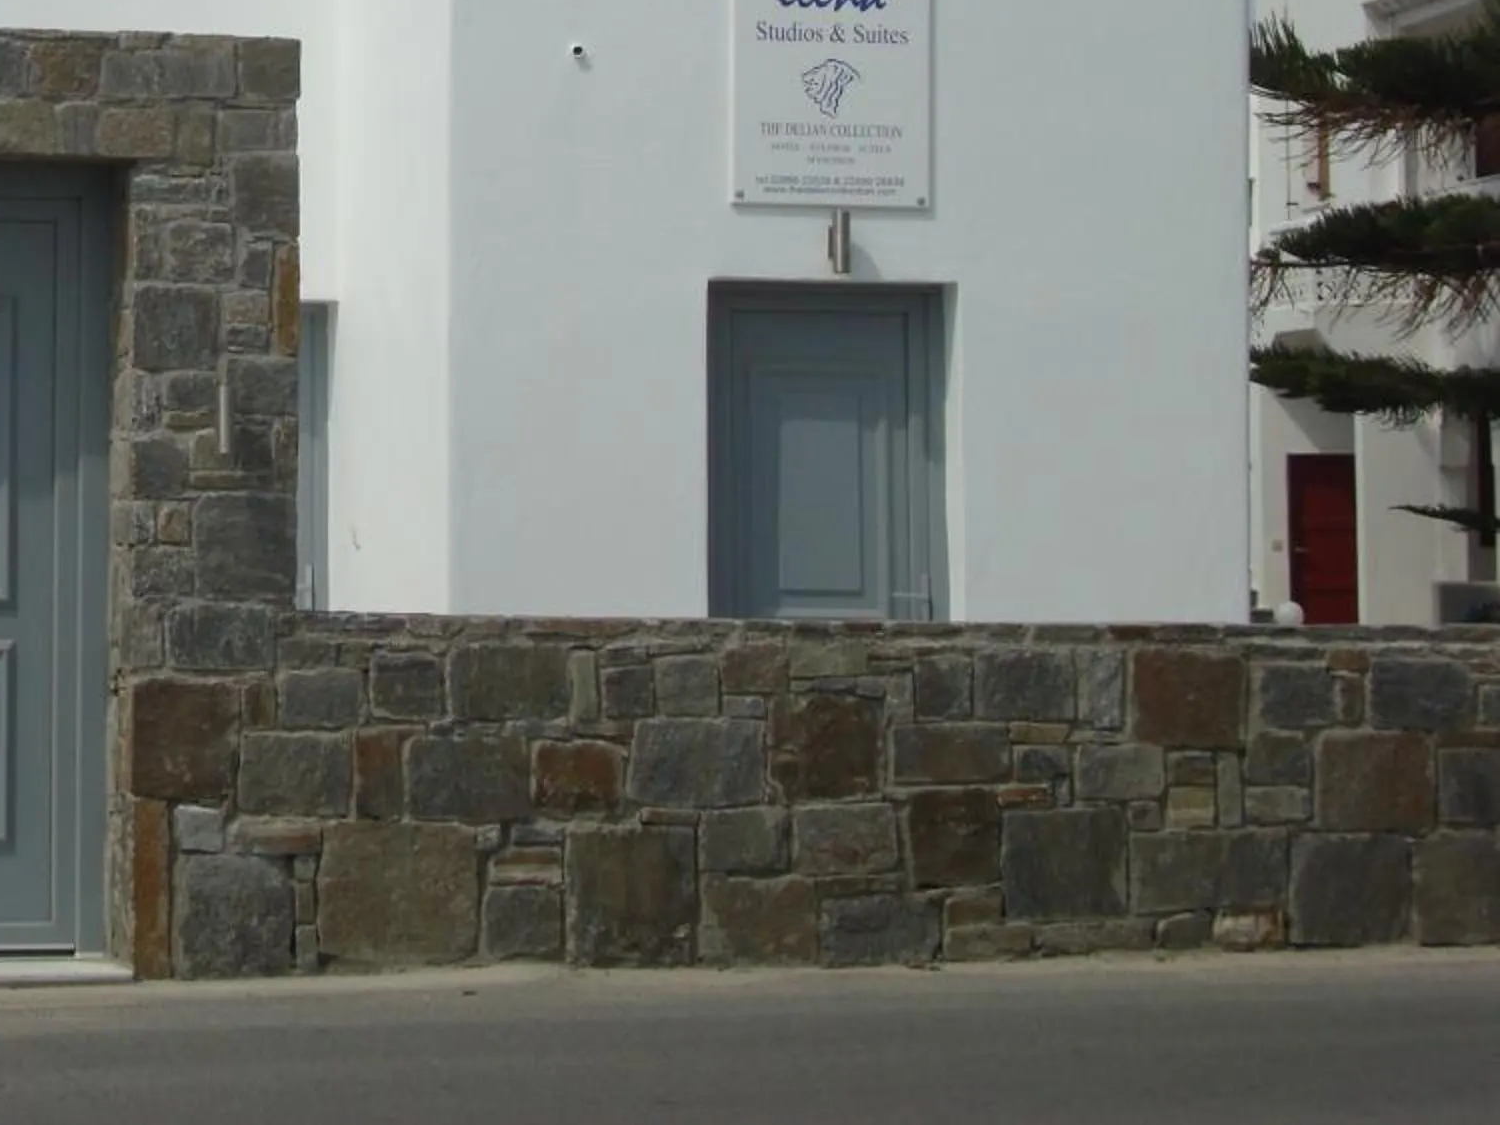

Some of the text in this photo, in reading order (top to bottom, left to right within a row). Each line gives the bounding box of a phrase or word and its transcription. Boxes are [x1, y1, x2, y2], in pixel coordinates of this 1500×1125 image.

[756, 21, 910, 44] Studios & Suites
[760, 121, 904, 139] THE DELIAN COLLECTION
